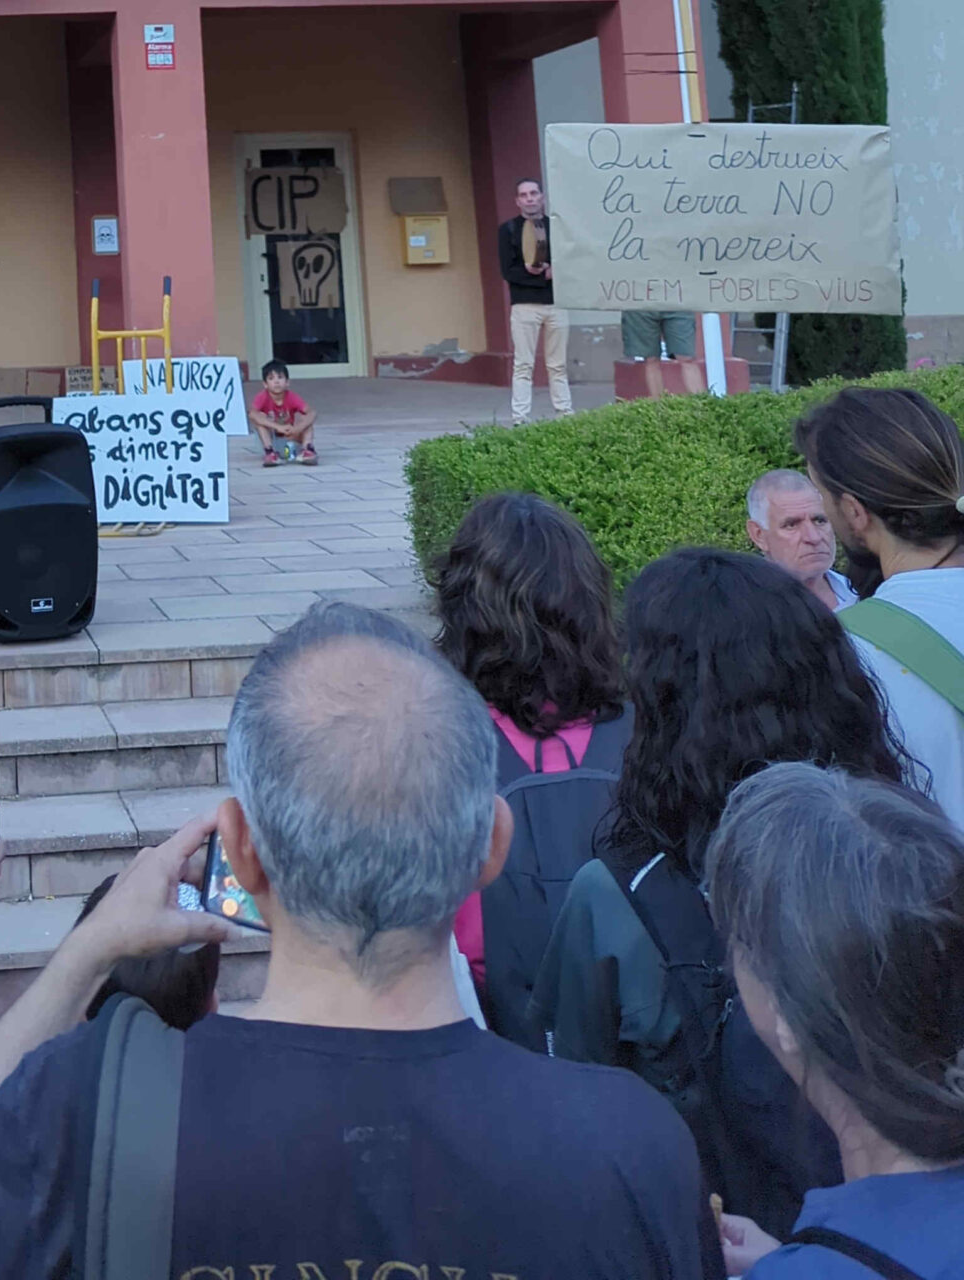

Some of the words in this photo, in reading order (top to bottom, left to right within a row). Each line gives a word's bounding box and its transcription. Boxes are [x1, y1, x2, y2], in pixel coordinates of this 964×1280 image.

[588, 128, 672, 169] Qui
[708, 130, 849, 171] destrueix
[251, 174, 319, 231] CIP
[602, 175, 641, 214] la
[663, 176, 747, 214] terra
[773, 179, 834, 215] NO
[608, 217, 649, 261] la
[677, 233, 822, 263] mereix
[599, 279, 683, 302] VOLEM
[709, 277, 799, 302] POBLES
[146, 361, 225, 392] NATURGY
[171, 408, 225, 439] que
[107, 437, 203, 462] diners
